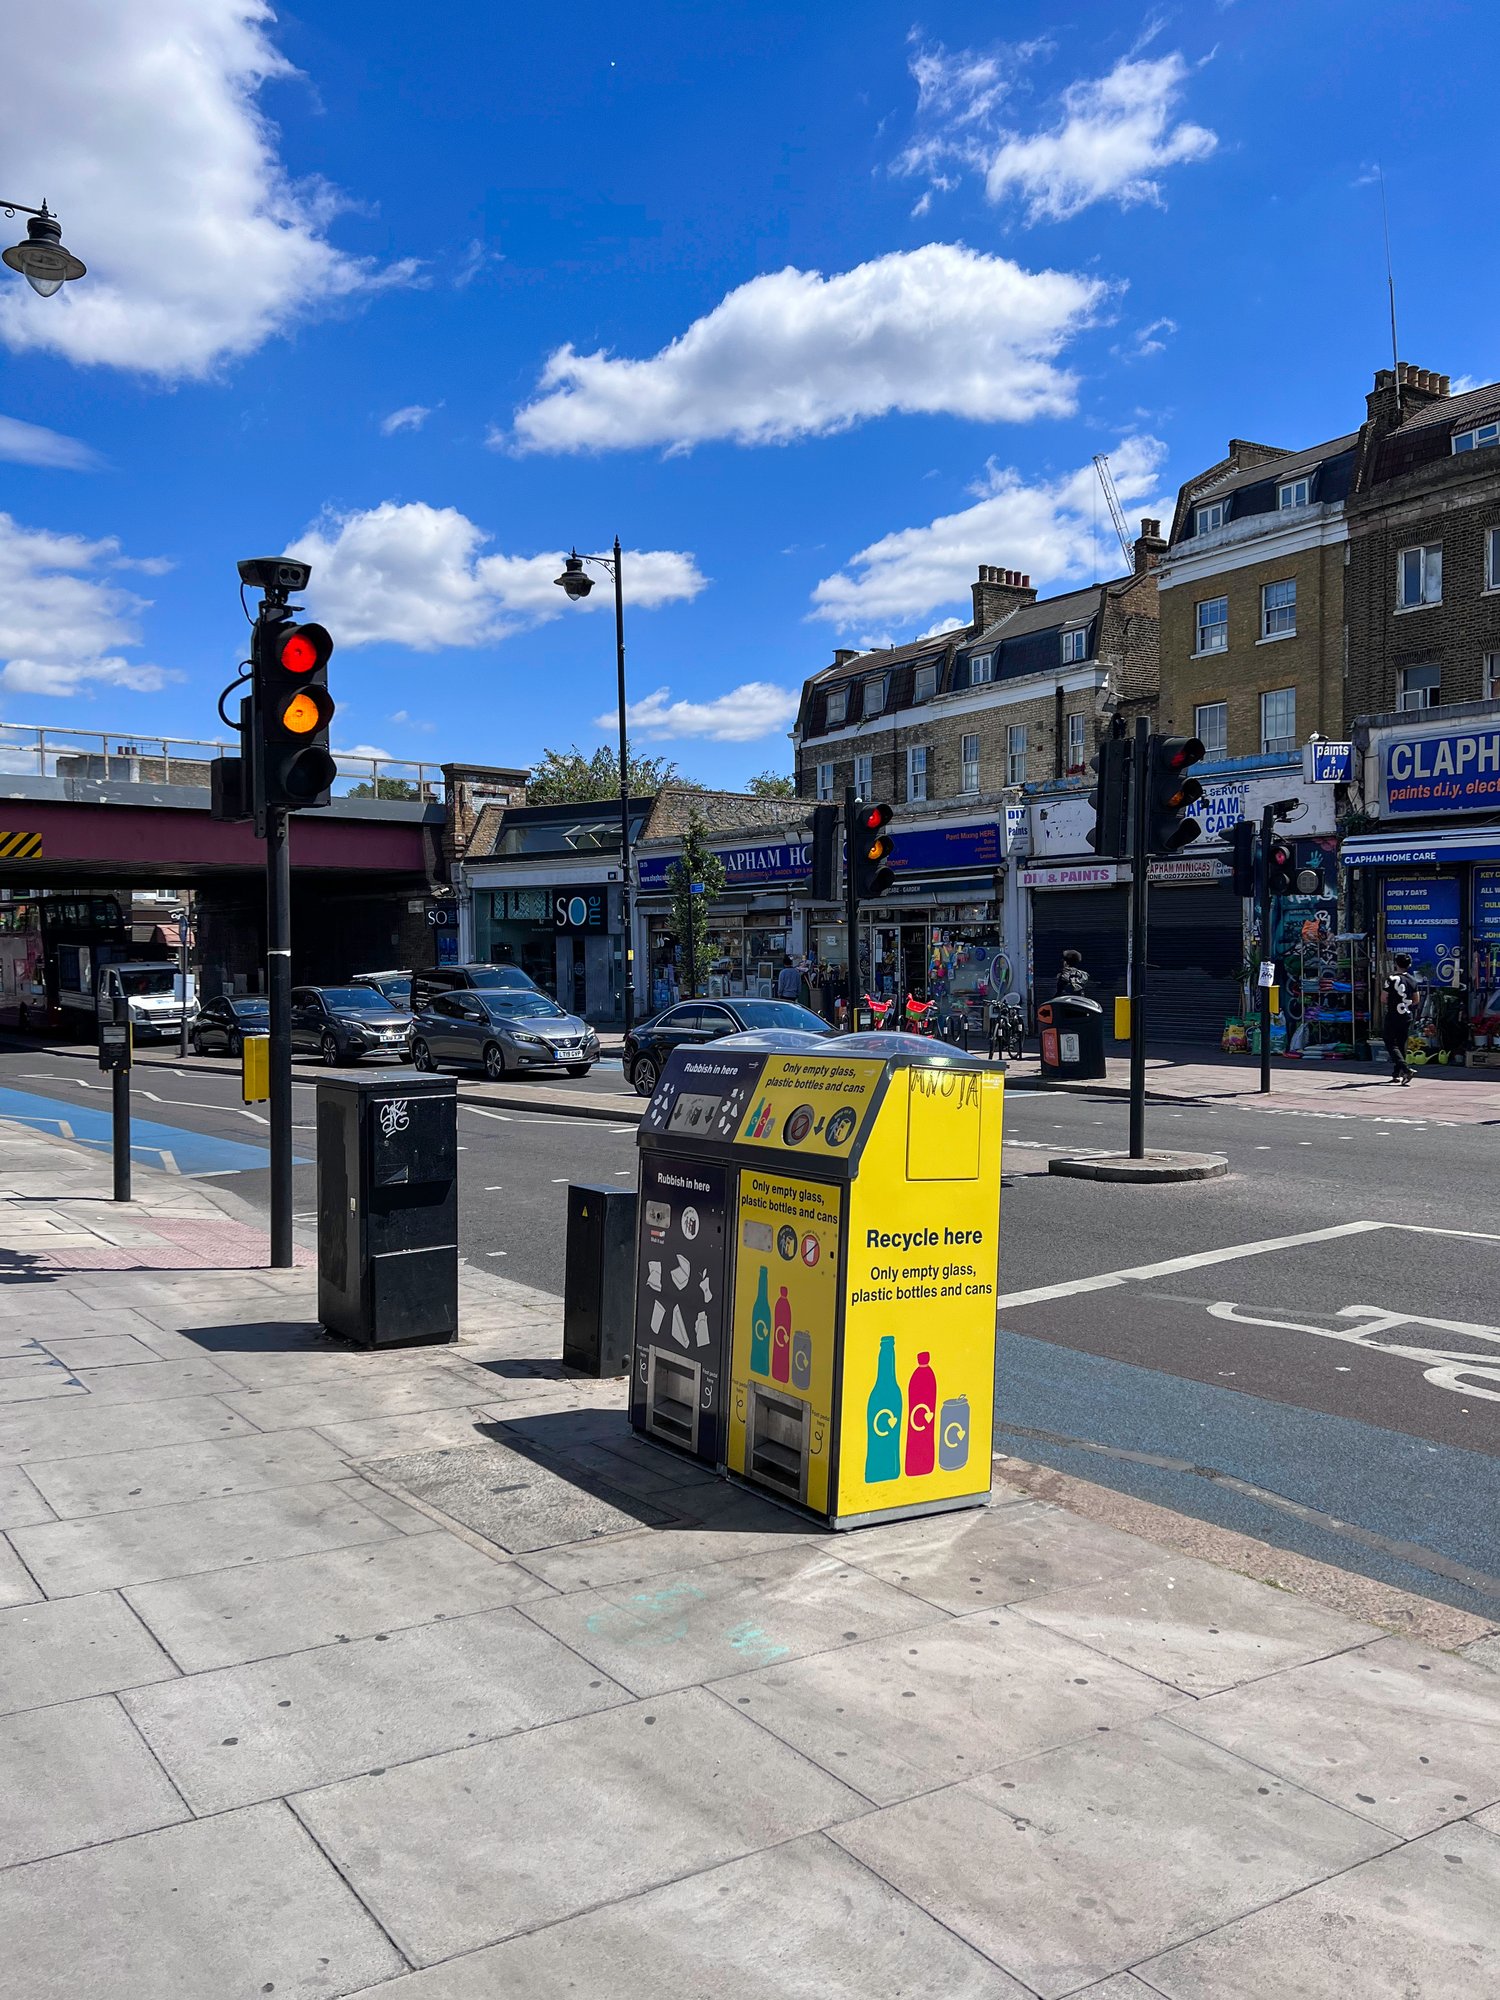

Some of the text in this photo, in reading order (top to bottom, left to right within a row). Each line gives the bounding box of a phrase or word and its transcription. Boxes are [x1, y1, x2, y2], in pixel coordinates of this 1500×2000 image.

[1317, 745, 1348, 758] paints
[1391, 736, 1500, 780] CLAPH
[1210, 785, 1249, 797] SERVICE
[1390, 786, 1431, 803] paints
[1433, 782, 1462, 800] d.i.y.
[1007, 810, 1026, 819] DIY
[1185, 797, 1239, 817] APHAM
[979, 830, 996, 838] HERE
[1008, 827, 1028, 837] Paints
[726, 846, 812, 871] APHAM HO
[1344, 852, 1436, 864] CLAPHAM HOME CARE
[1048, 873, 1057, 883] &
[1060, 869, 1109, 882] PAINTS
[1149, 863, 1174, 874] APHAM
[1175, 861, 1210, 872] MINICABS
[427, 910, 448, 926] SO
[556, 896, 588, 926] SO
[684, 1062, 738, 1075] Rubbish in here
[783, 1062, 802, 1076] Only
[802, 1065, 830, 1077] empty
[830, 1068, 856, 1078] glass,
[765, 1077, 865, 1094] plastic bottles and cans
[658, 1172, 711, 1193] Rubbish in here
[752, 1179, 825, 1206] Only empty glass,
[741, 1194, 838, 1225] plastic bottles and cans
[866, 1227, 983, 1251] Recycle here
[870, 1263, 977, 1282] Only empty glass,
[851, 1282, 992, 1306] plastic bottles and cans
